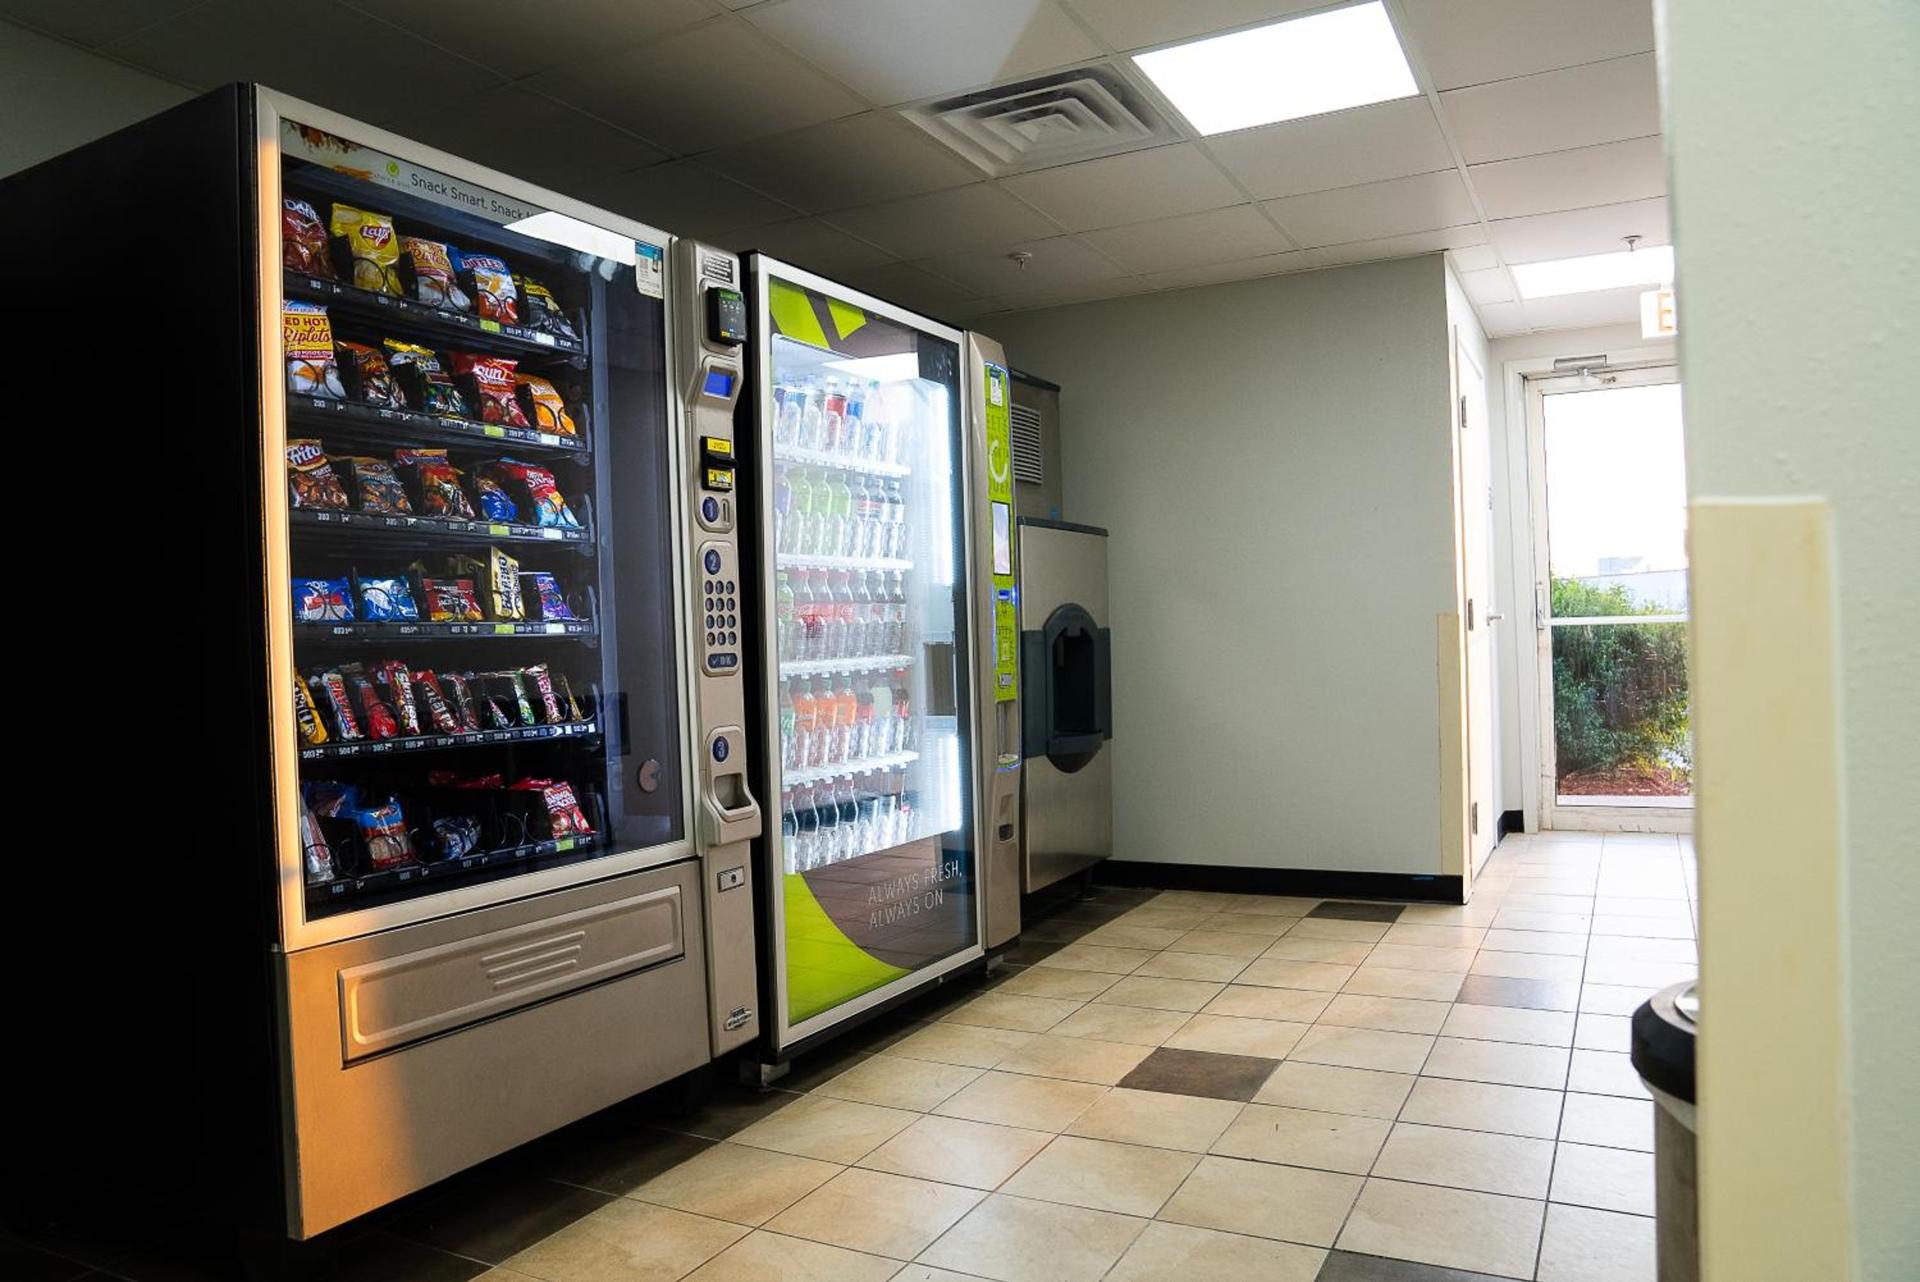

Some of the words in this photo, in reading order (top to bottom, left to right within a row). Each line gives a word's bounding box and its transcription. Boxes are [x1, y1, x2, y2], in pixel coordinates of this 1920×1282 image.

[410, 173, 449, 196] Snack
[490, 200, 524, 220] Snack
[303, 318, 327, 326] HOT
[868, 873, 919, 905] ALWAYS
[869, 896, 920, 929] ALWAYS
[924, 889, 943, 910] ON
